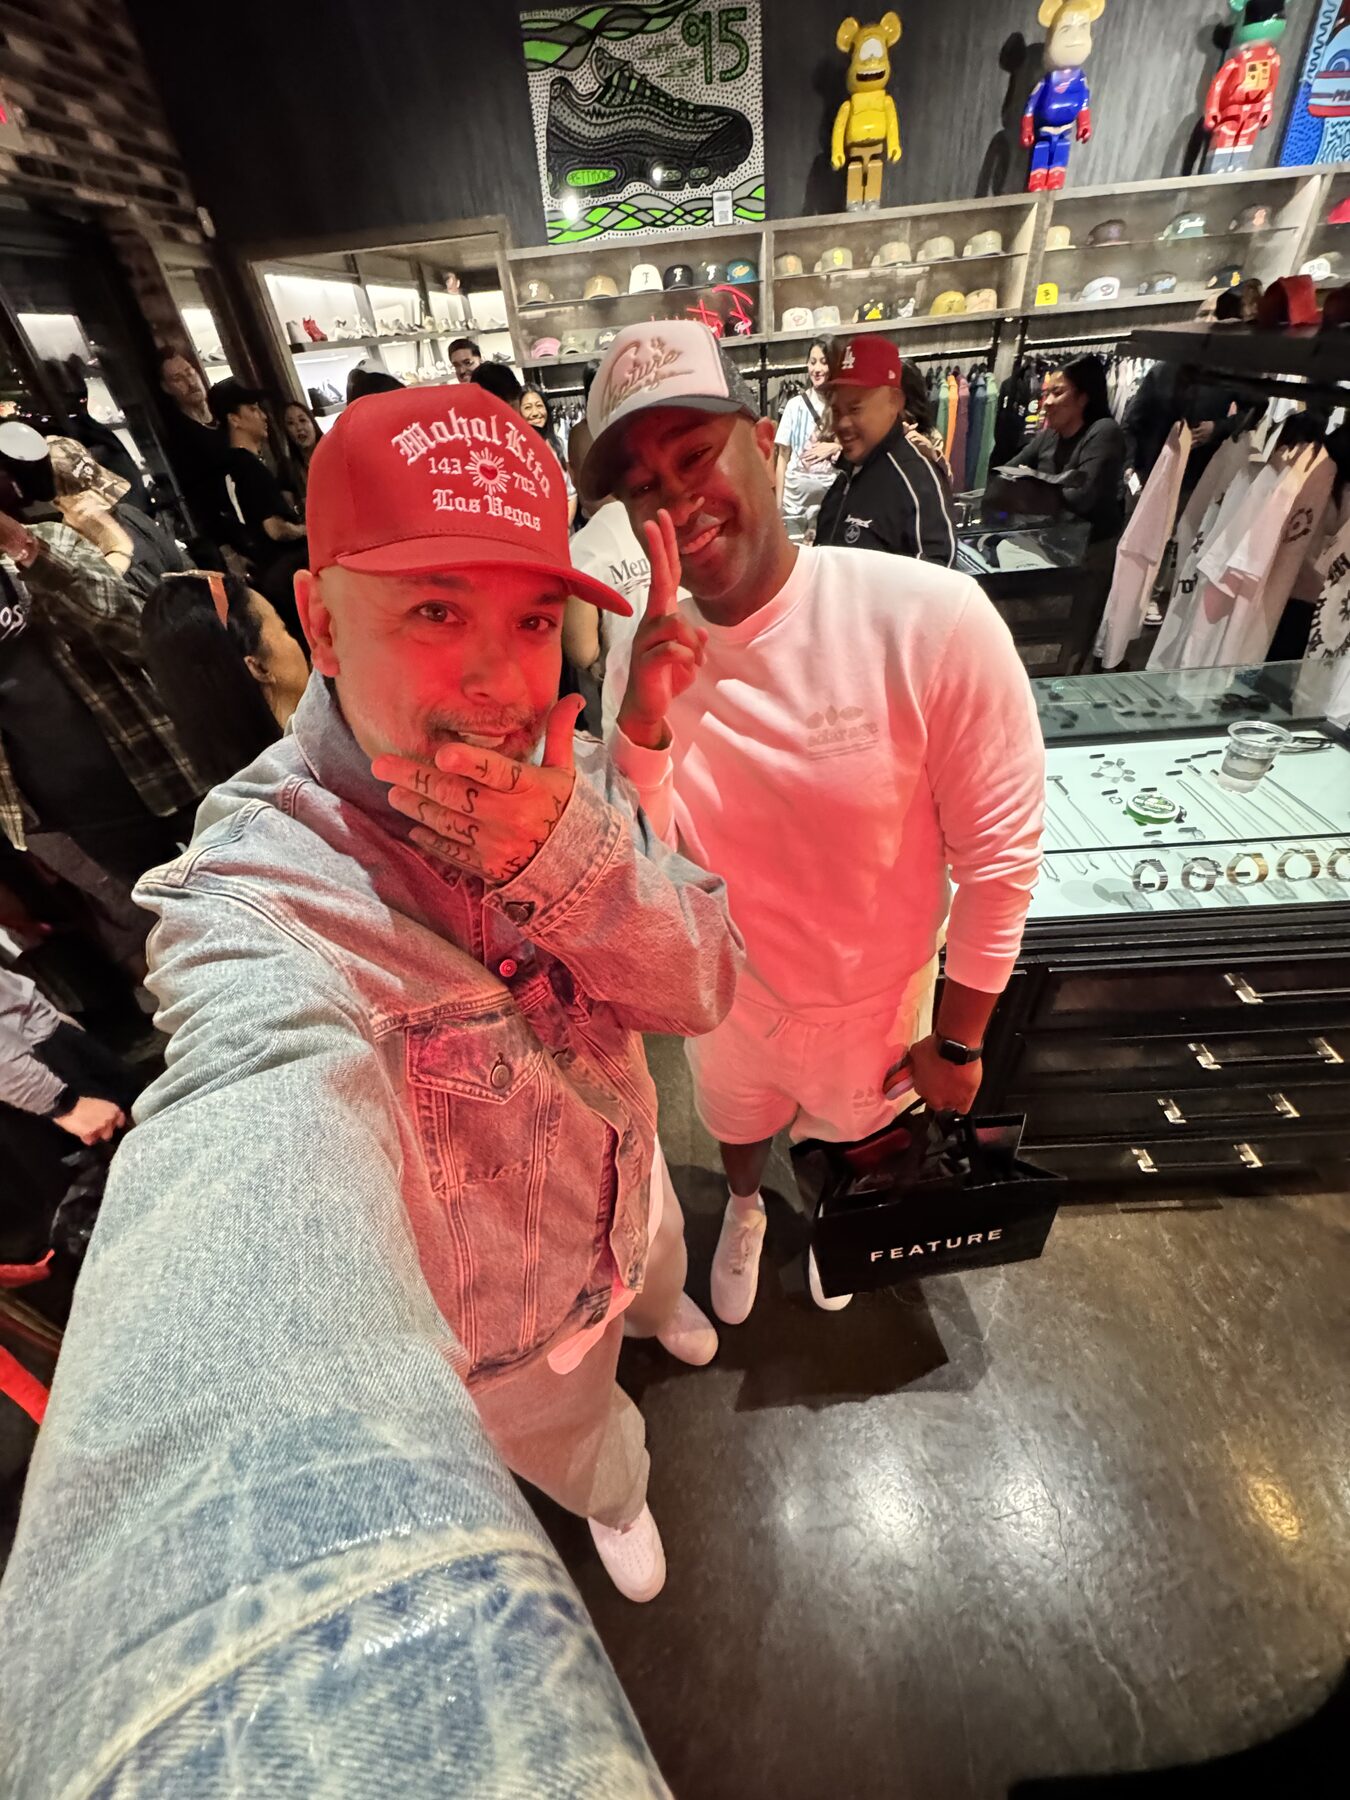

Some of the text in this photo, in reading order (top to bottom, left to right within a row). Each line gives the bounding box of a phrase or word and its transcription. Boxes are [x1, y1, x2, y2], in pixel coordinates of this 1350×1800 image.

[681, 7, 750, 85] 95
[391, 407, 502, 466] Mahal
[429, 457, 538, 498] 143 702
[432, 488, 542, 532] Las Vegas
[870, 1229, 1003, 1262] FEATURE
